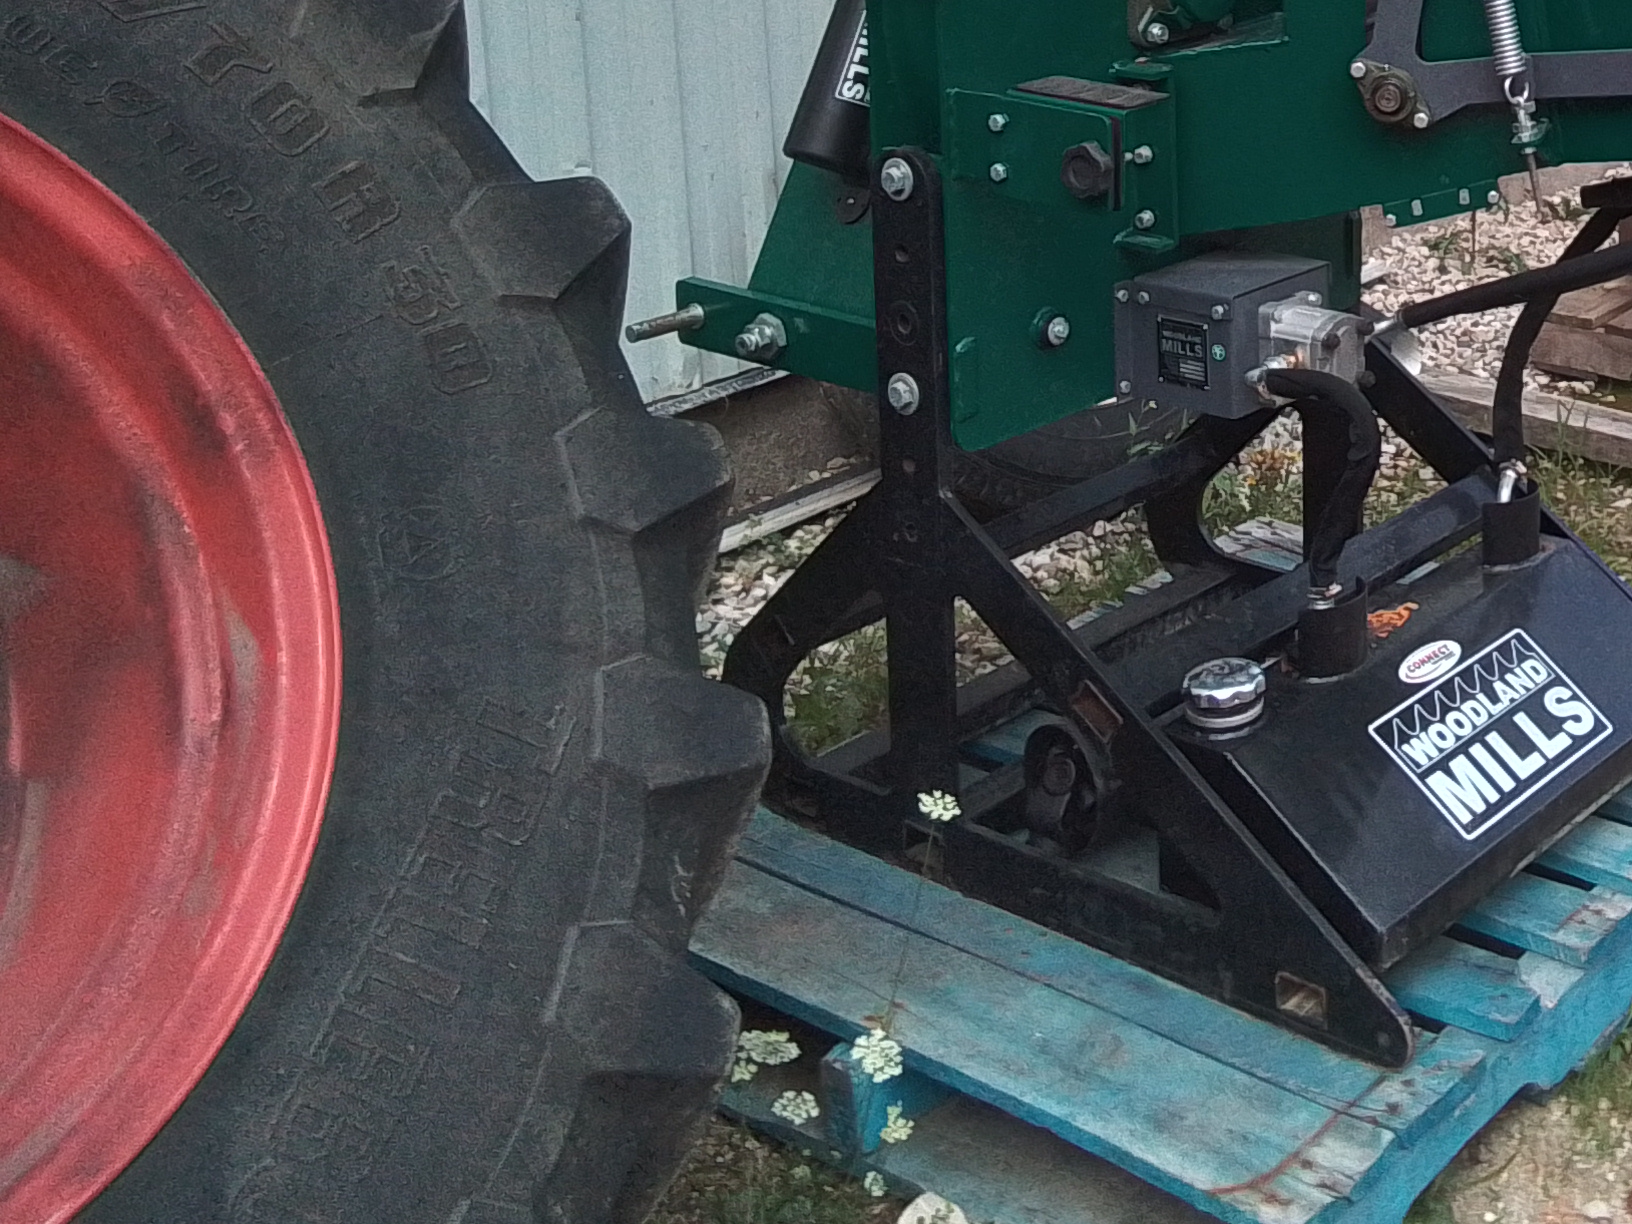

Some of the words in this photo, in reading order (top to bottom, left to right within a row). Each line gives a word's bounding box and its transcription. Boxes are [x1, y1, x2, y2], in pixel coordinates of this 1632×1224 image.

[1161, 338, 1203, 358] MILLS
[1406, 644, 1450, 673] CONNECT
[1402, 659, 1548, 766] WOODLAND
[1425, 686, 1595, 824] MILLS
